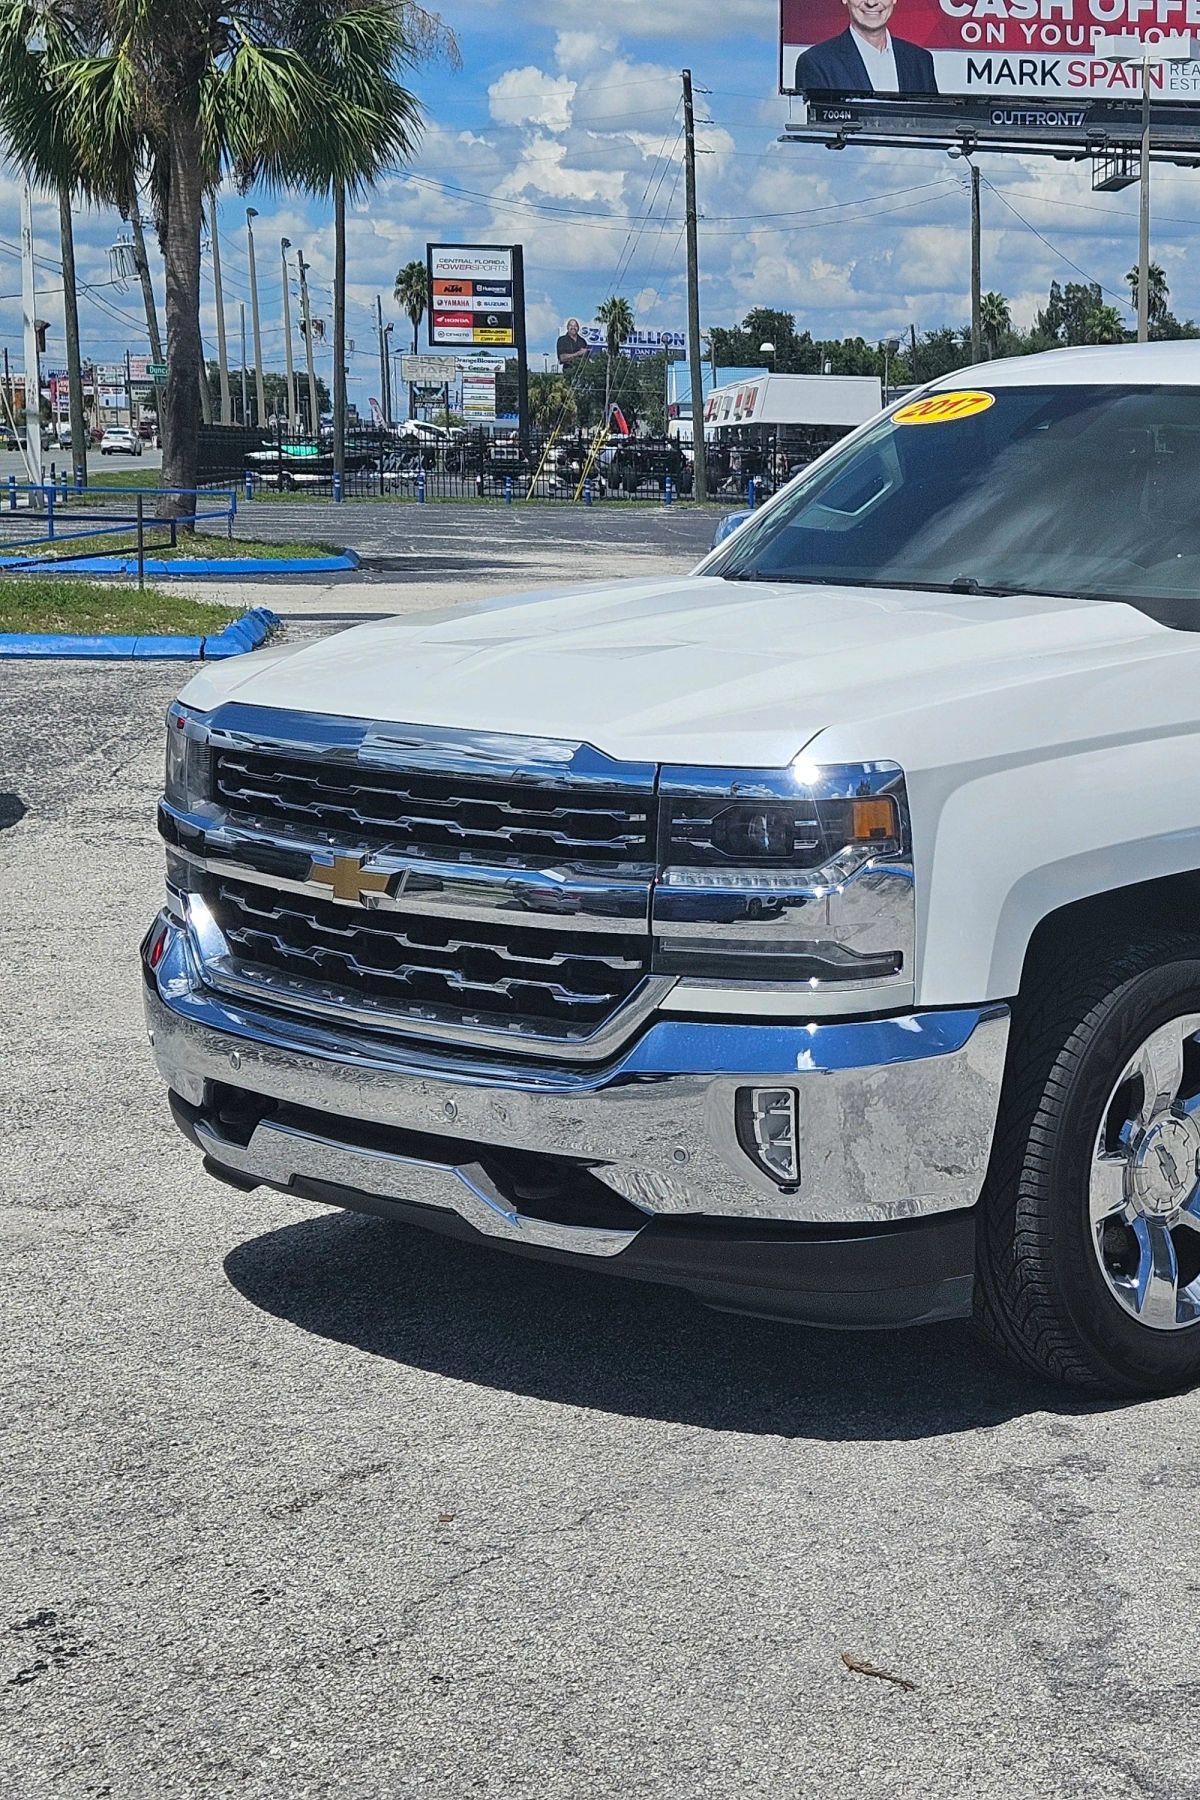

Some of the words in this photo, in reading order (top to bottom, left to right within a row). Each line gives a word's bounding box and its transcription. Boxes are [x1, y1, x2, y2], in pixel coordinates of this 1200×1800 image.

[960, 22, 1005, 44] ON
[1019, 23, 1106, 46] YOUR
[966, 57, 1062, 87] MARK
[1066, 61, 1164, 90] SPAIN
[822, 110, 851, 120] 7004N
[436, 264, 509, 272] POWERSPORTS
[443, 299, 470, 307] YAMAHA
[149, 366, 168, 374] Dunc
[407, 365, 450, 374] STAR
[896, 397, 990, 420] 2017
